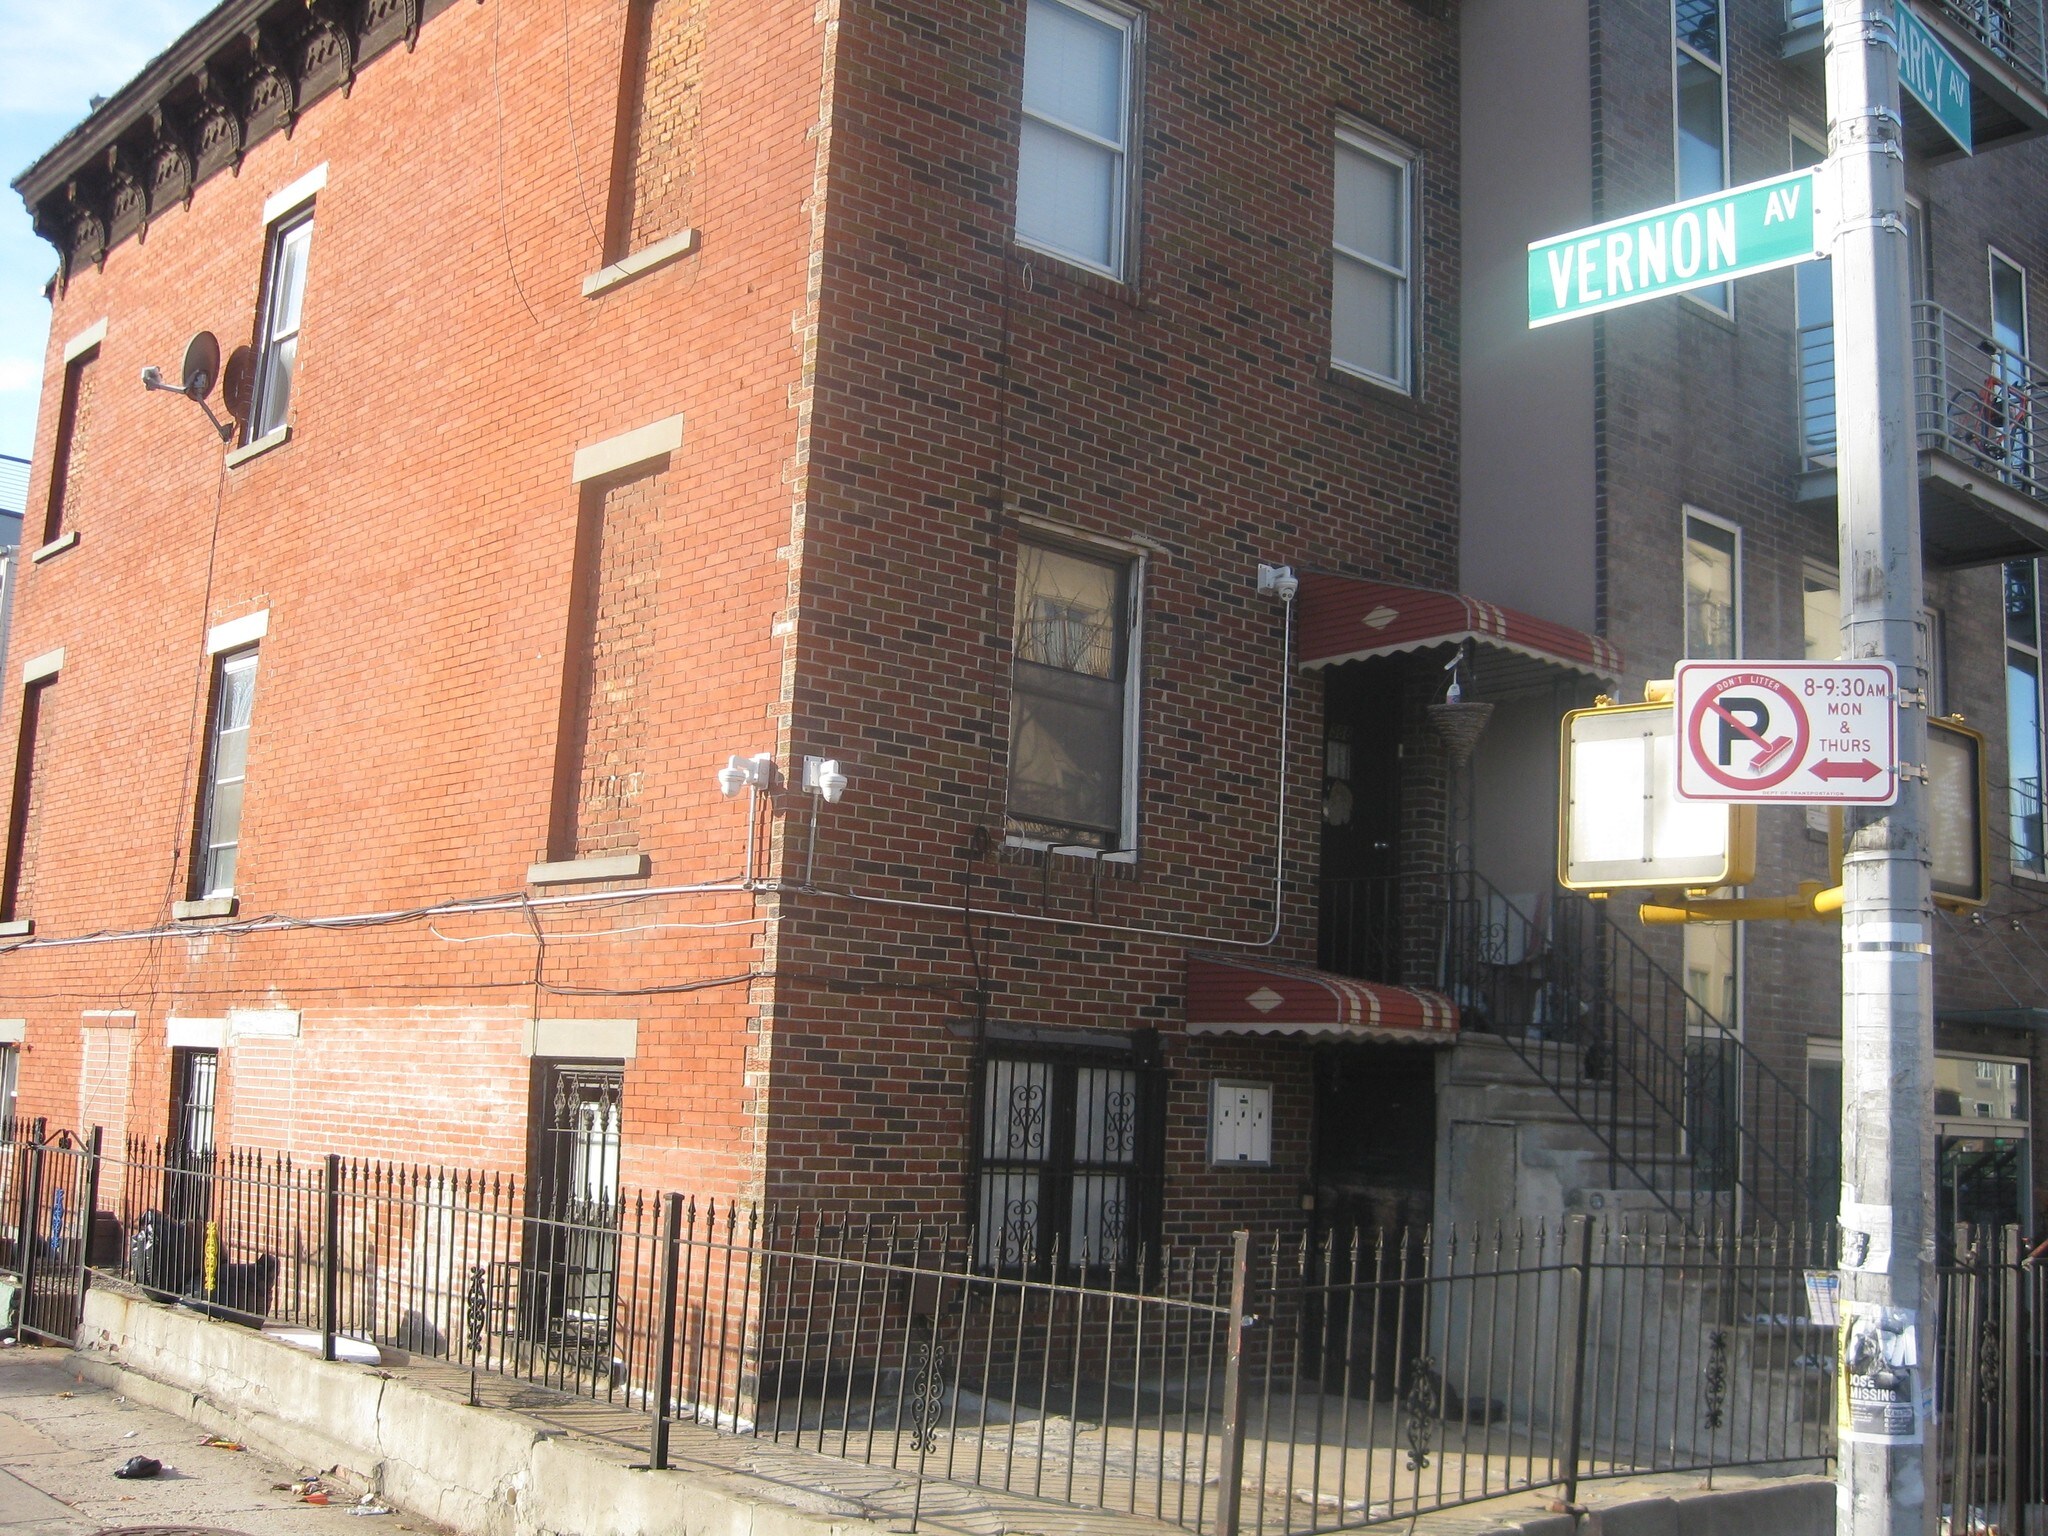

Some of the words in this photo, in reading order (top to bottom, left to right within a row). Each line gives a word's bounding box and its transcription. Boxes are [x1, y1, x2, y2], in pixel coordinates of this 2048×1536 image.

[1898, 13, 1944, 113] ARCY
[1949, 69, 1964, 108] AV
[1548, 202, 1736, 308] VERNON
[1764, 184, 1801, 226] AV
[1716, 676, 1743, 692] DON'T
[1750, 676, 1781, 691] LITTER
[1828, 702, 1862, 716] MON
[1840, 721, 1851, 734] &
[1819, 739, 1871, 752] THURS
[1850, 1386, 1897, 1402] MISSING
